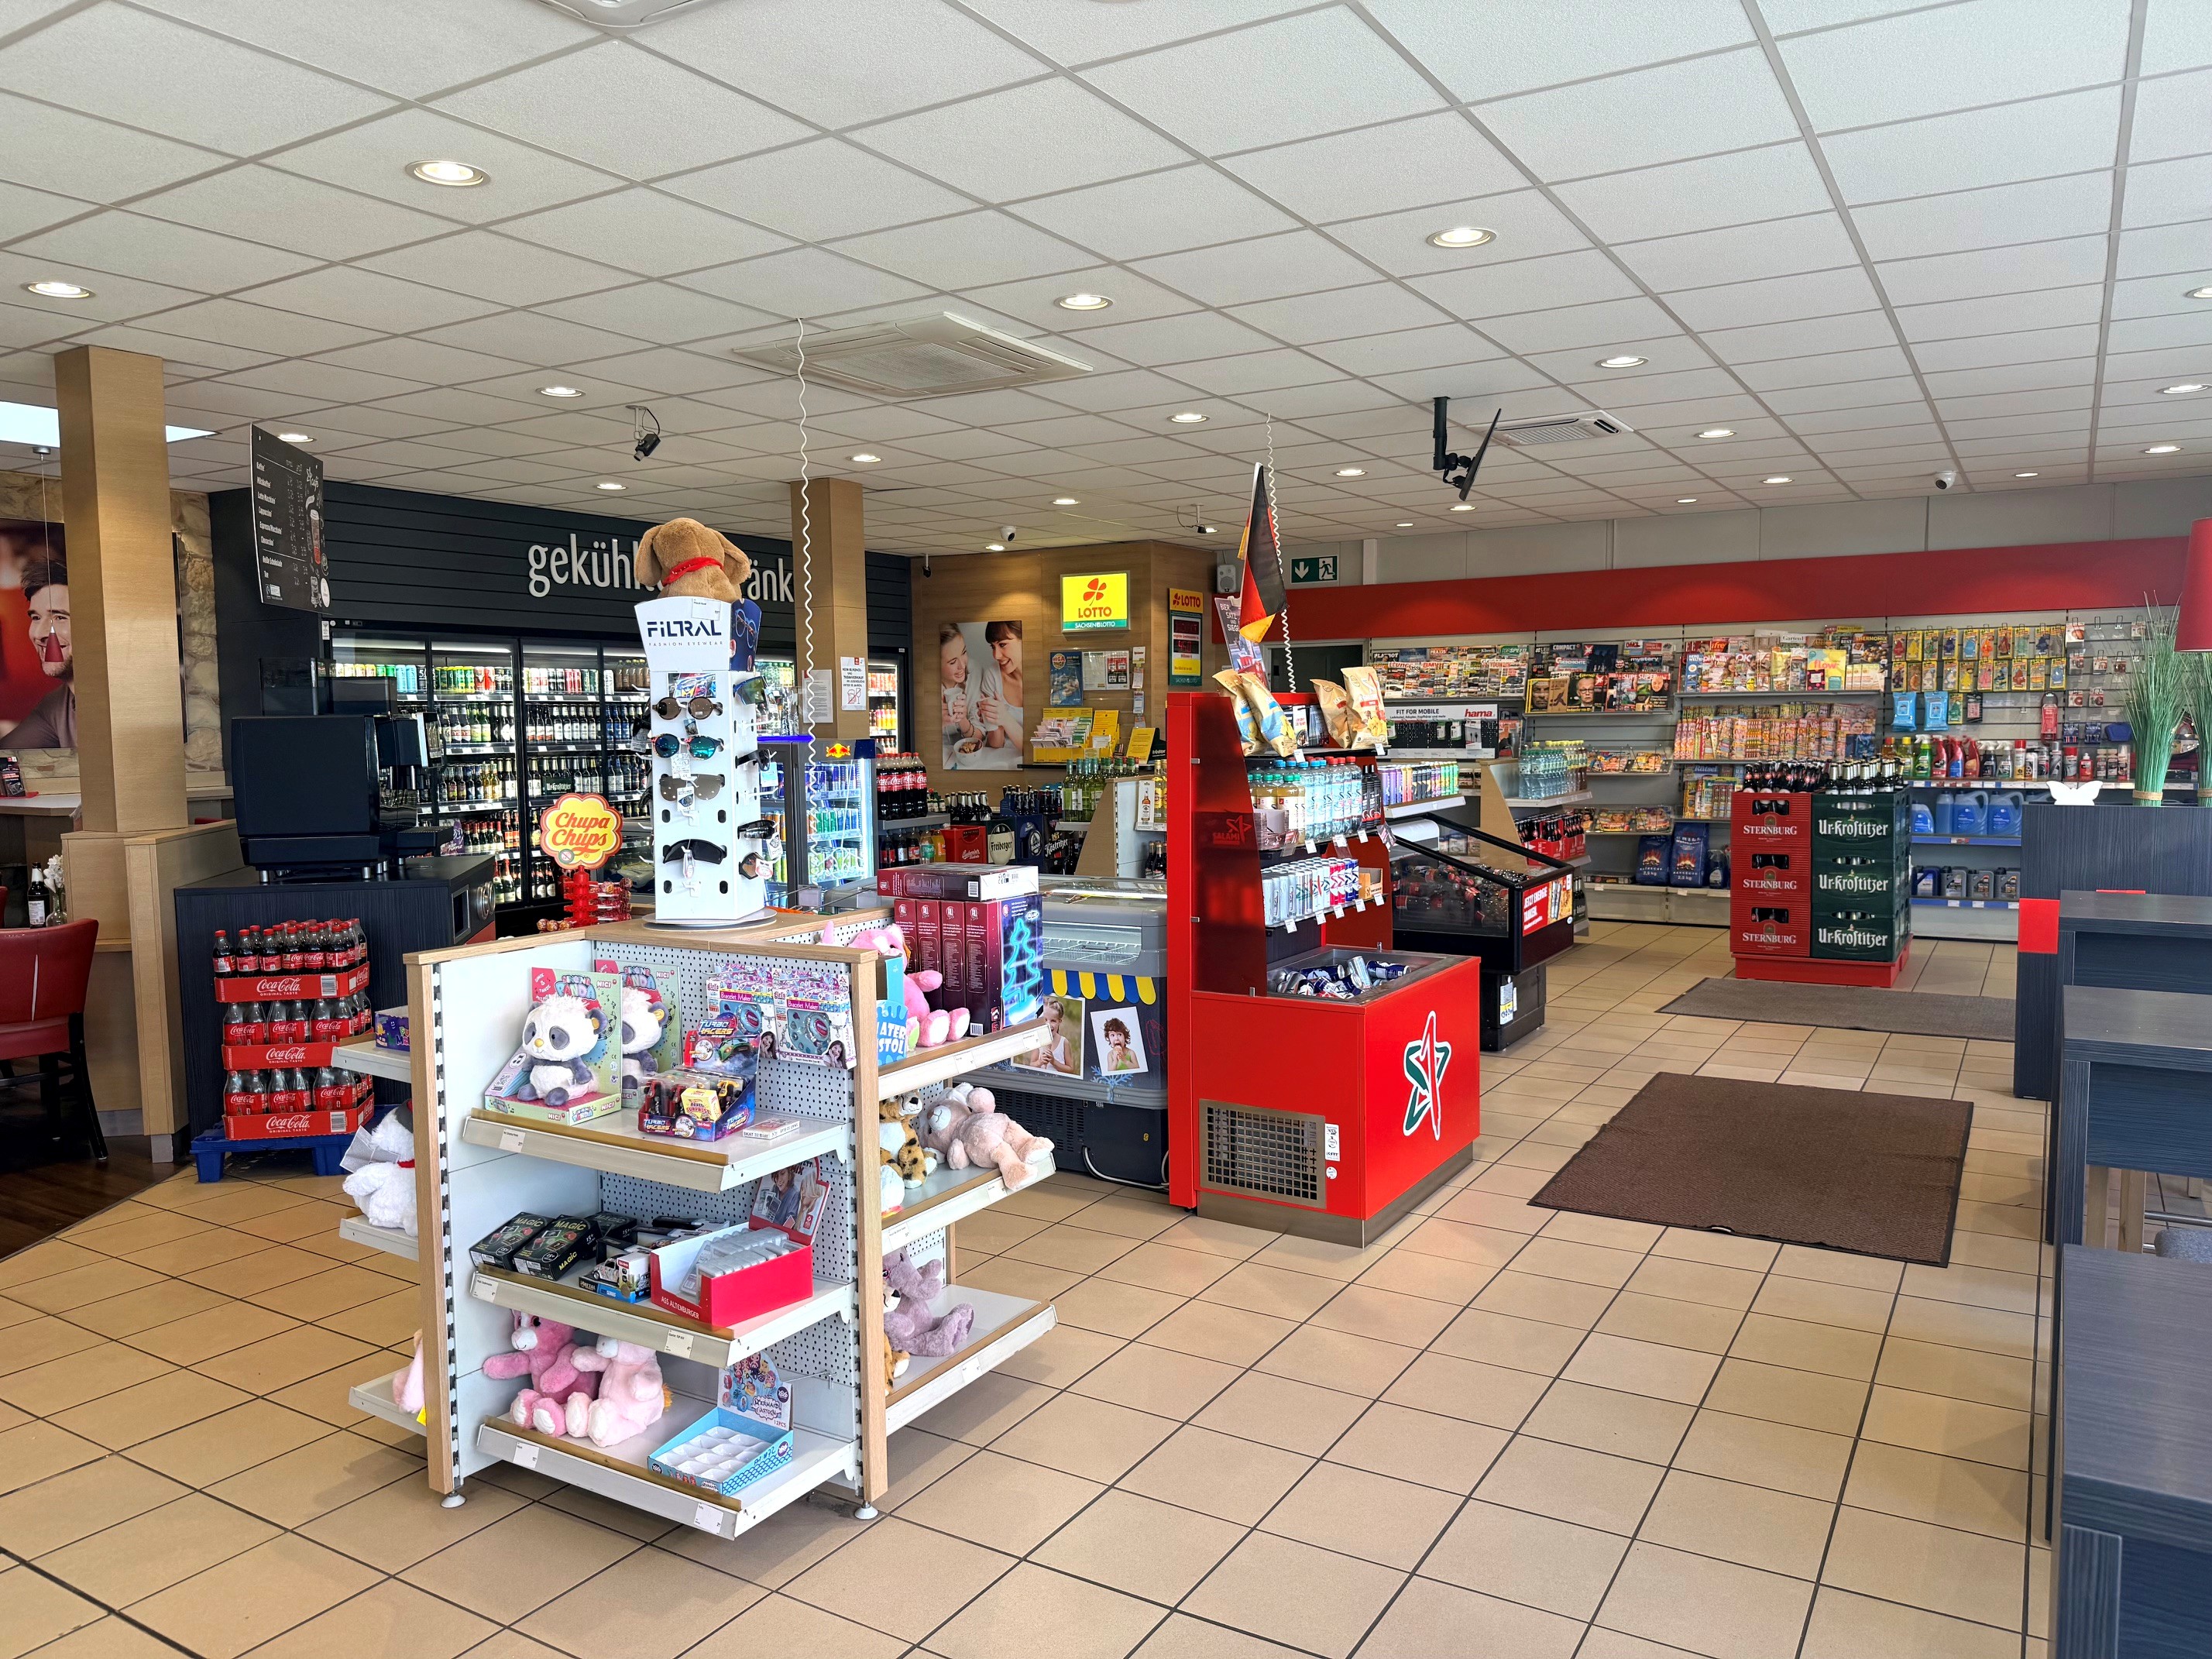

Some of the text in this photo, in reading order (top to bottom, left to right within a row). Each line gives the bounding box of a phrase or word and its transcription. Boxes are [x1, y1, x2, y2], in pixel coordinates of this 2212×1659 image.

[1181, 594, 1200, 608] LOTTO
[1078, 606, 1112, 618] LOTTO
[1814, 659, 1836, 671] flow
[1465, 709, 1492, 718] hama
[555, 812, 610, 833] Chupa
[1743, 825, 1797, 836] STERNBURG
[551, 829, 607, 855] Chups
[990, 841, 1013, 852] Freiberger
[1044, 839, 1068, 857] Köstritzer
[1743, 879, 1797, 890] STERNBURG
[1743, 933, 1796, 944] STERNBURG
[256, 977, 301, 993] Coca-Cola
[555, 981, 596, 1000] PANDA
[720, 991, 752, 1002] Bracelet Maker
[788, 1000, 819, 1012] Bracelet Maker
[231, 1025, 257, 1035] Coca-Cola
[273, 1022, 297, 1032] Coca-Cola
[316, 1022, 341, 1031] Coca-Cola
[699, 1020, 729, 1029] TURBO
[266, 1047, 306, 1060] Coca-Cola
[321, 1087, 346, 1097] Coca-Cola
[601, 1101, 615, 1111] NICI
[266, 1115, 311, 1130] Coca-Cola
[661, 1296, 700, 1321] ASS ALTENBURGER
